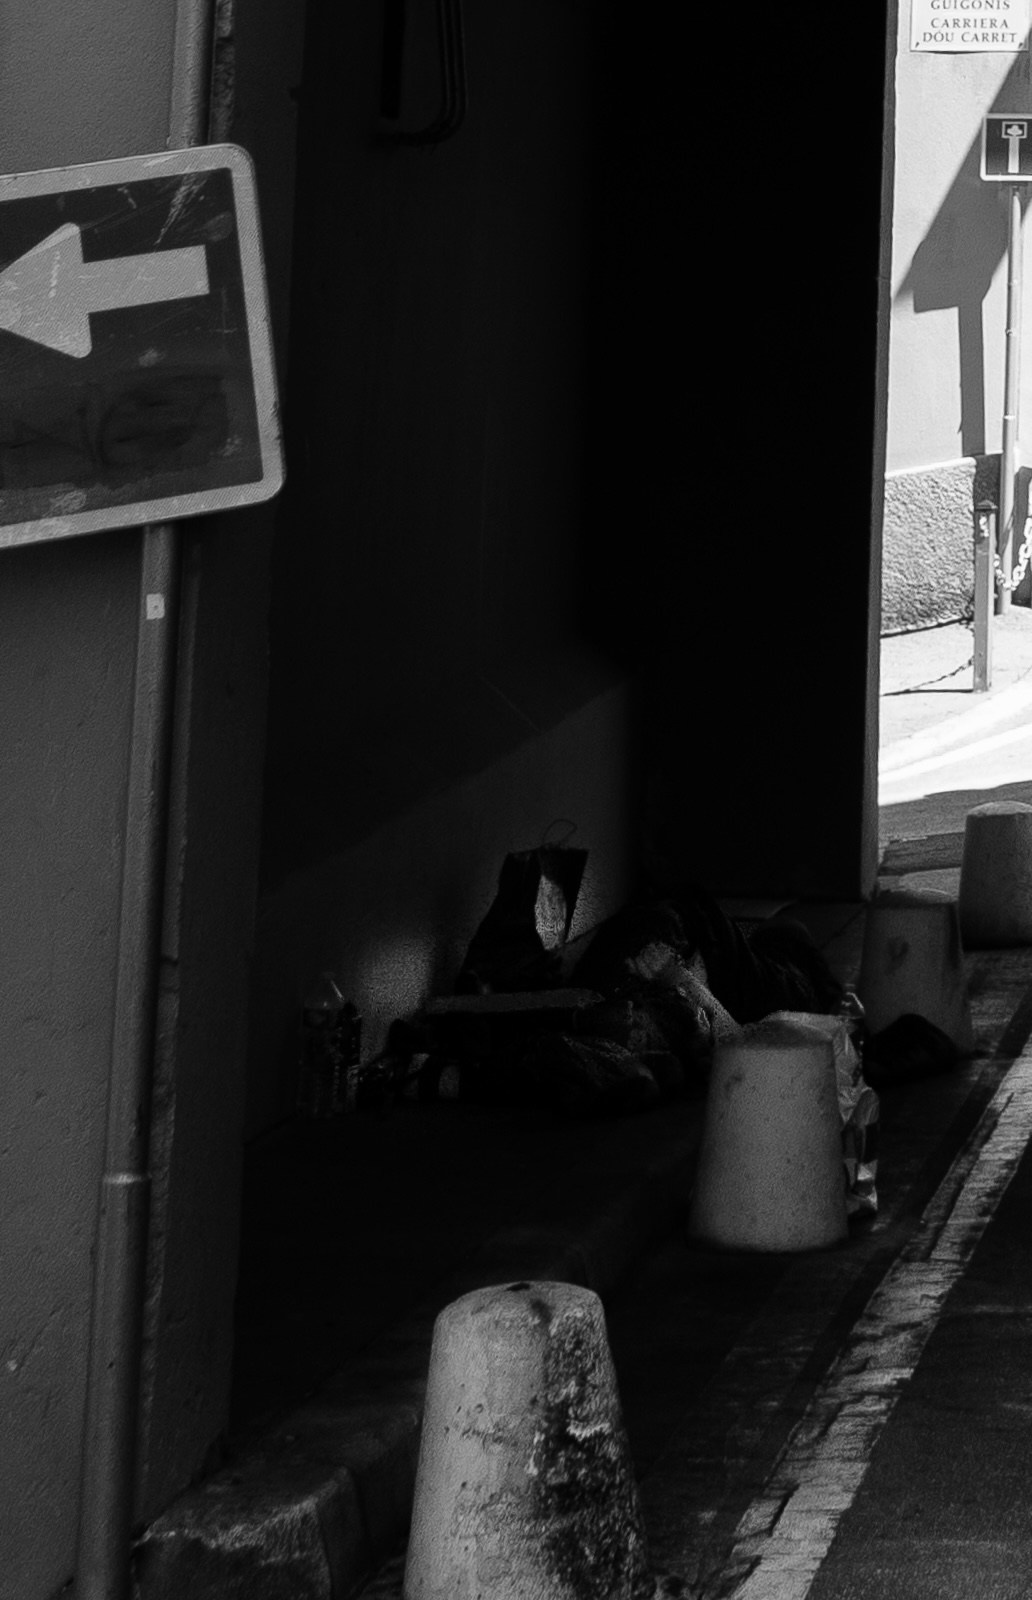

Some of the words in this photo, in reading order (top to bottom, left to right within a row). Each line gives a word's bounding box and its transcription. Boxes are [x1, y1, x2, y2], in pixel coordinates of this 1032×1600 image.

[930, 0, 1010, 10] GUIGONIS
[930, 17, 1009, 29] CARRIERA
[961, 32, 1017, 43] CARRET
